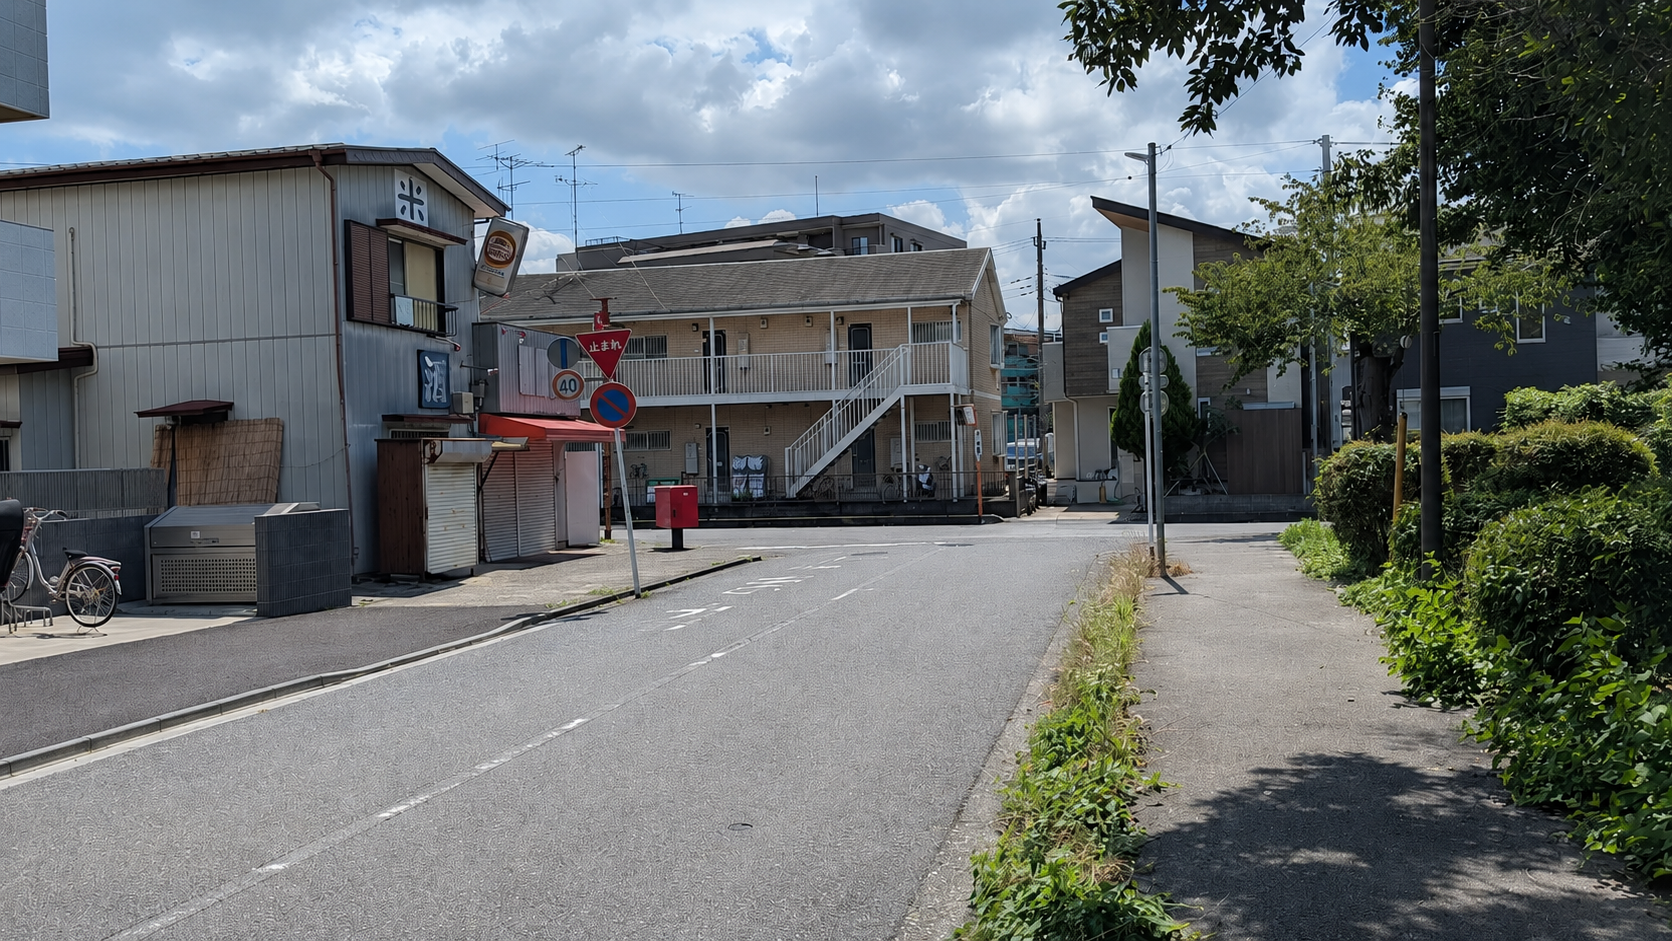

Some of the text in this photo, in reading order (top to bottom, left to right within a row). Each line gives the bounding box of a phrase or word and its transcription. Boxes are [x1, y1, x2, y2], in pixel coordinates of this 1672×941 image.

[398, 176, 424, 221] 米
[589, 339, 622, 353] 止まれ
[559, 378, 577, 394] 40
